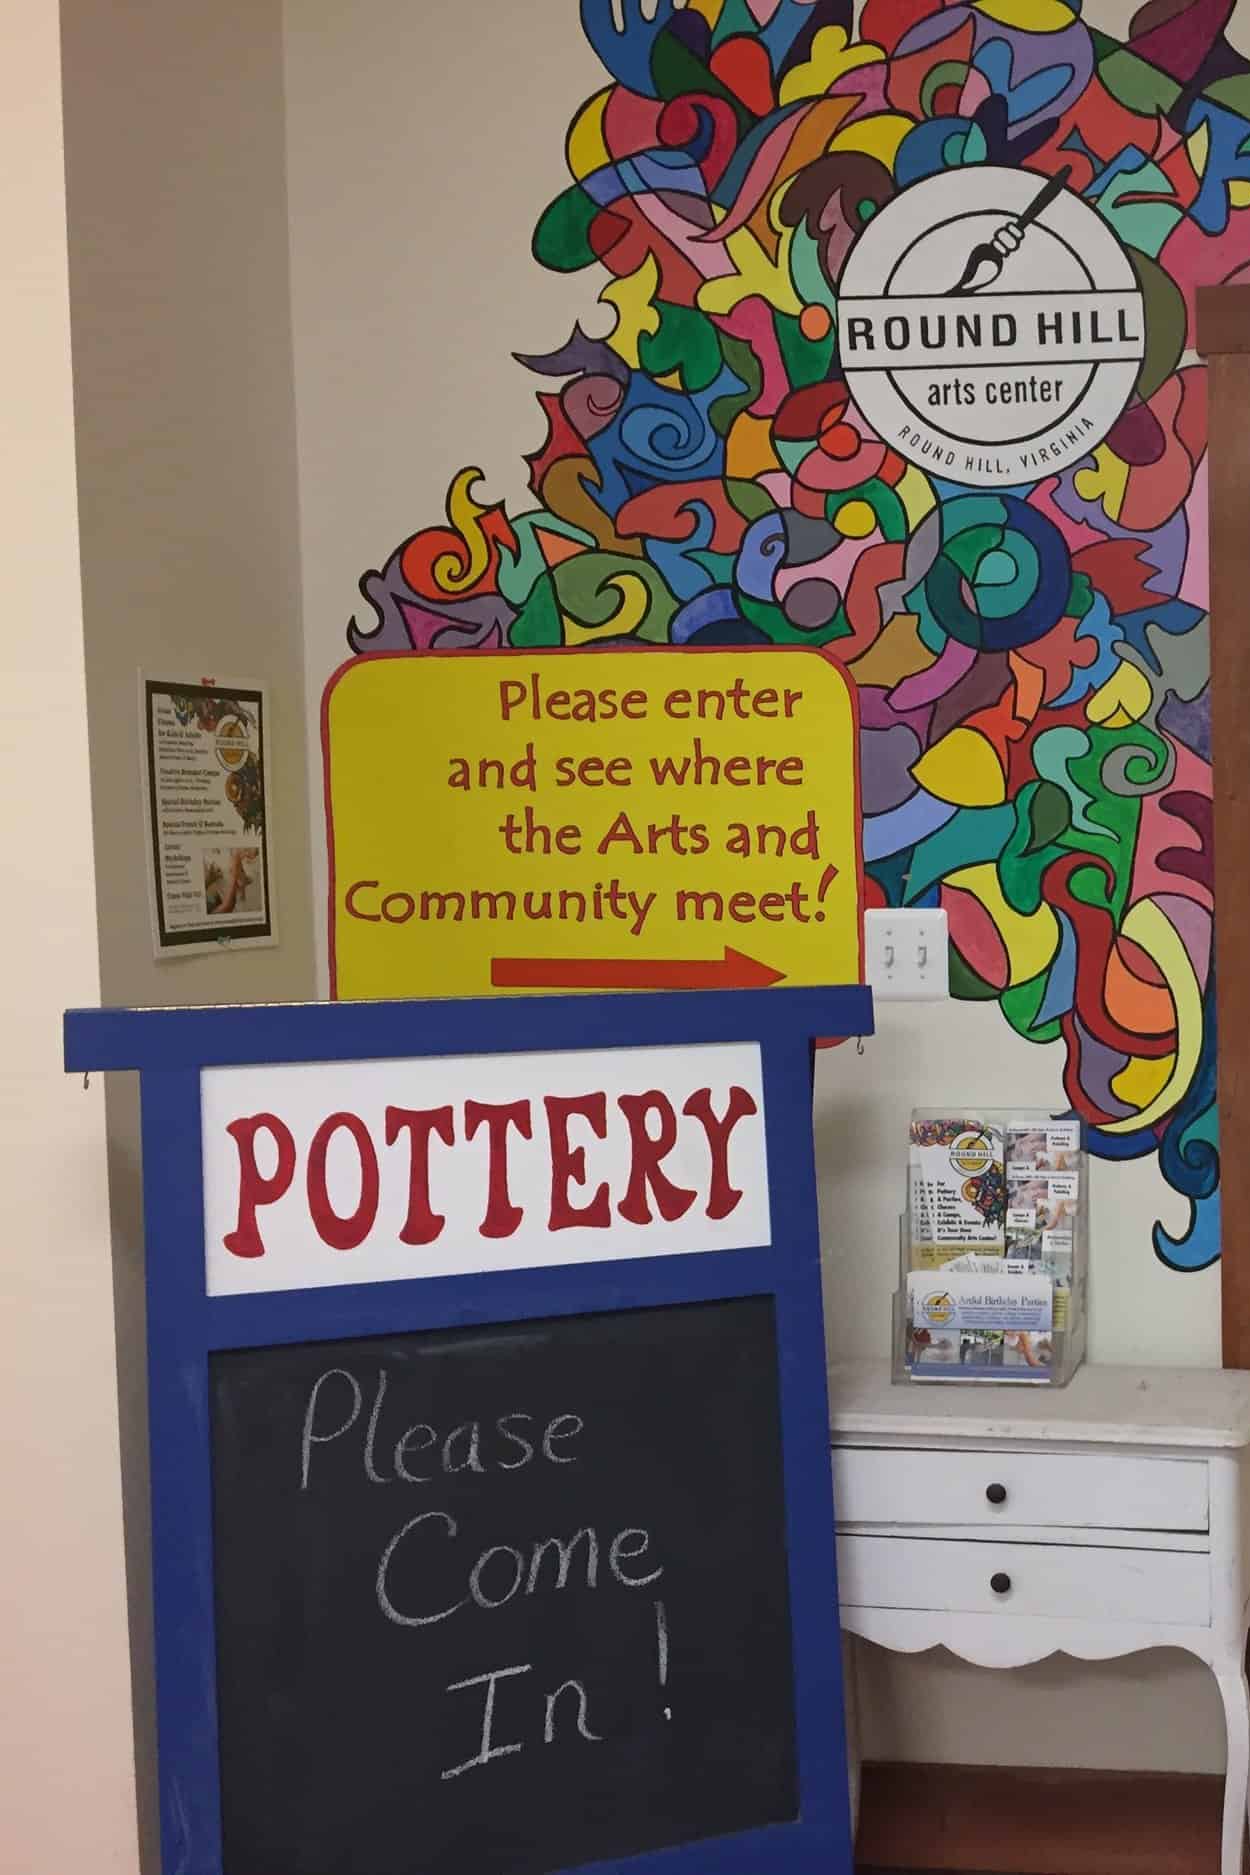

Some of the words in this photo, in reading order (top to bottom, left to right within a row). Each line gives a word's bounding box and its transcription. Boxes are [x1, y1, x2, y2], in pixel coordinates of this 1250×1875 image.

[847, 314, 1018, 351] ROUND
[1037, 308, 1141, 346] HILL
[928, 377, 976, 406] arts
[985, 375, 1063, 403] center
[898, 425, 956, 466] ROUND
[1020, 416, 1094, 469] VIRGINIA
[500, 672, 648, 722] Please
[664, 678, 803, 721] enter
[448, 743, 537, 791] and
[555, 756, 632, 787] see
[649, 737, 804, 787] where
[498, 806, 582, 855] the
[597, 812, 709, 855] Arts
[726, 810, 819, 860] and
[344, 880, 657, 936] Community
[676, 864, 839, 923] meet!
[223, 1086, 757, 1258] POTTERY
[300, 1368, 584, 1489] Please
[376, 1511, 663, 1626] Come
